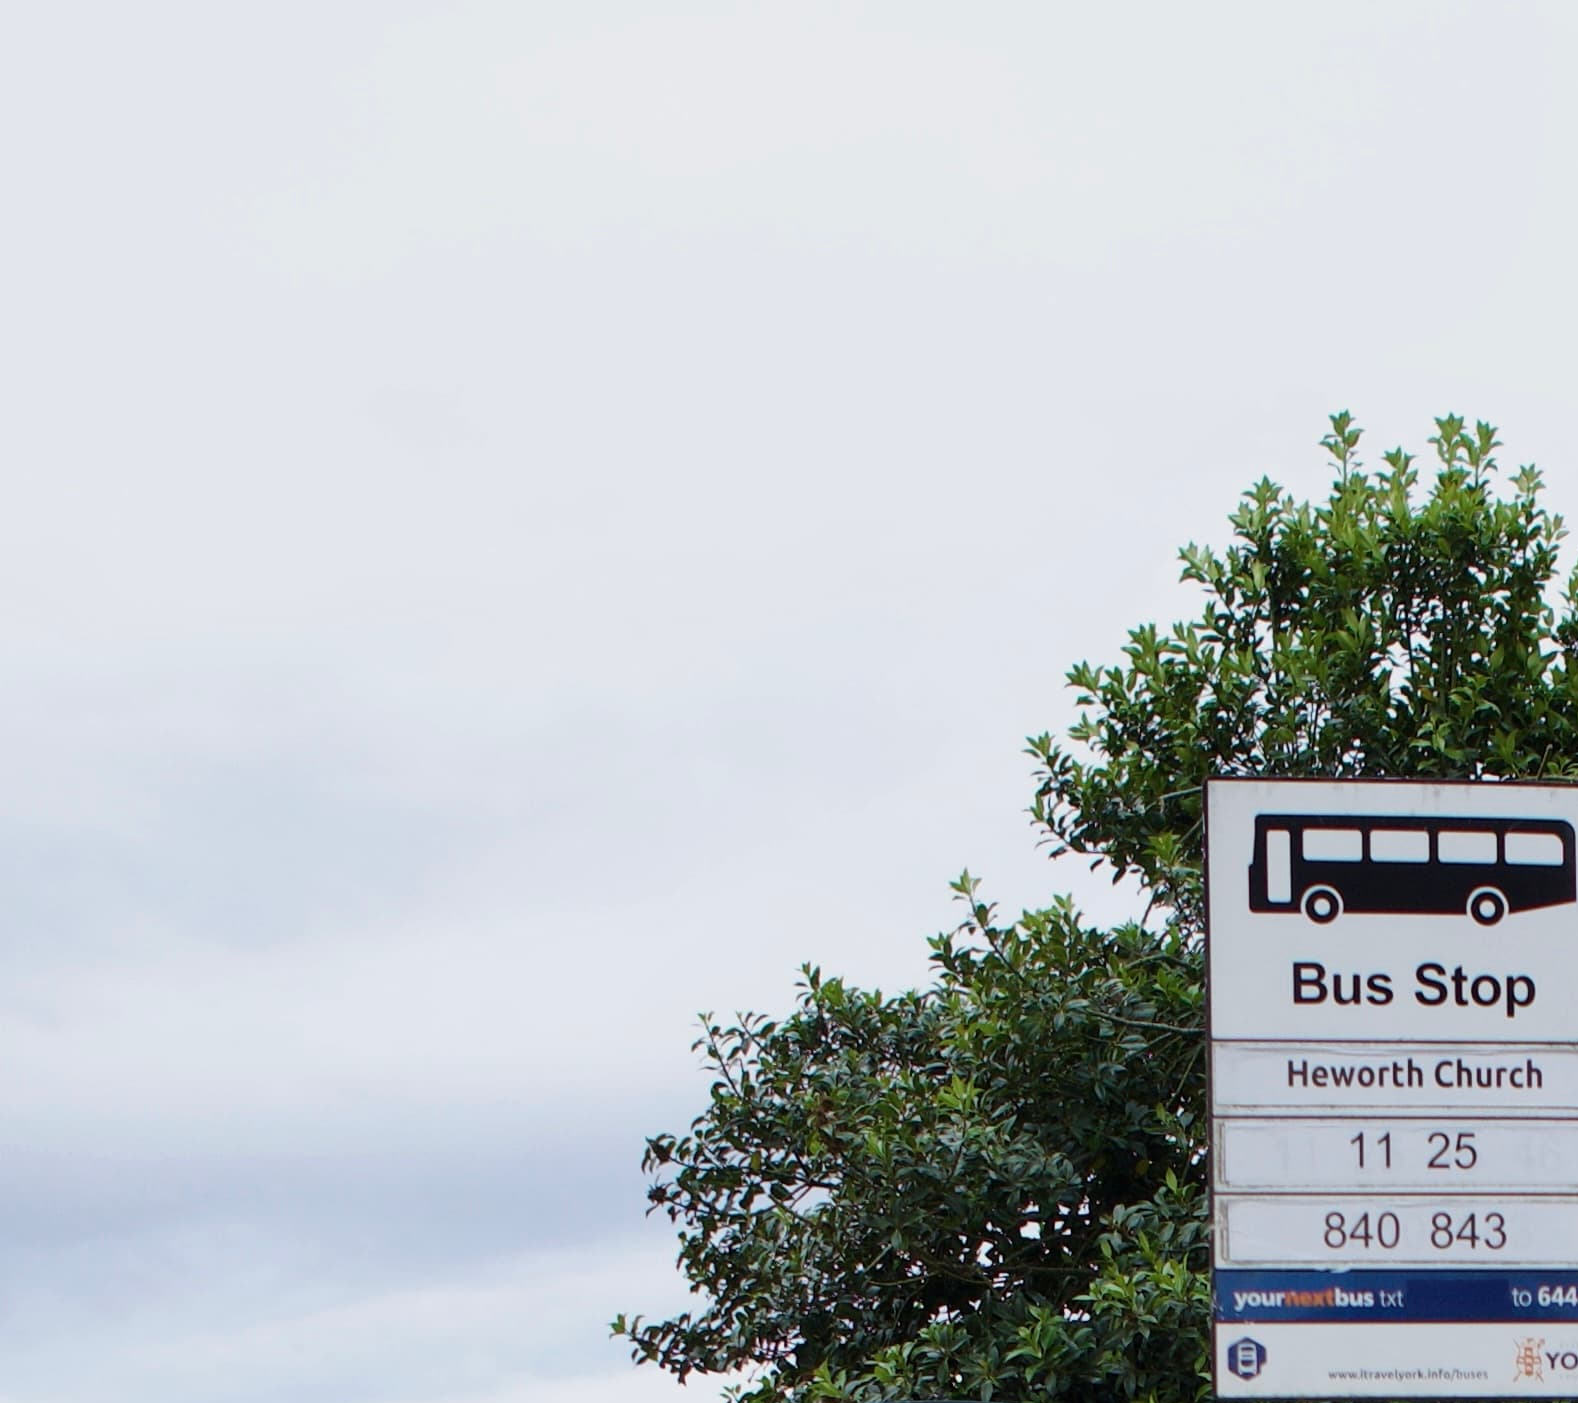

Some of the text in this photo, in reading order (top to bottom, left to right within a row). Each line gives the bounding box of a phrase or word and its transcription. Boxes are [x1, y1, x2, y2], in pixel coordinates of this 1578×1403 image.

[1292, 962, 1536, 1018] Bus Stop
[1288, 1058, 1543, 1089] Heworth Church
[1350, 1132, 1478, 1169] 11 25
[1323, 1212, 1508, 1250] 840 843
[1233, 1287, 1375, 1312] yournextbus
[1379, 1290, 1405, 1308] txt
[1511, 1287, 1533, 1307] to
